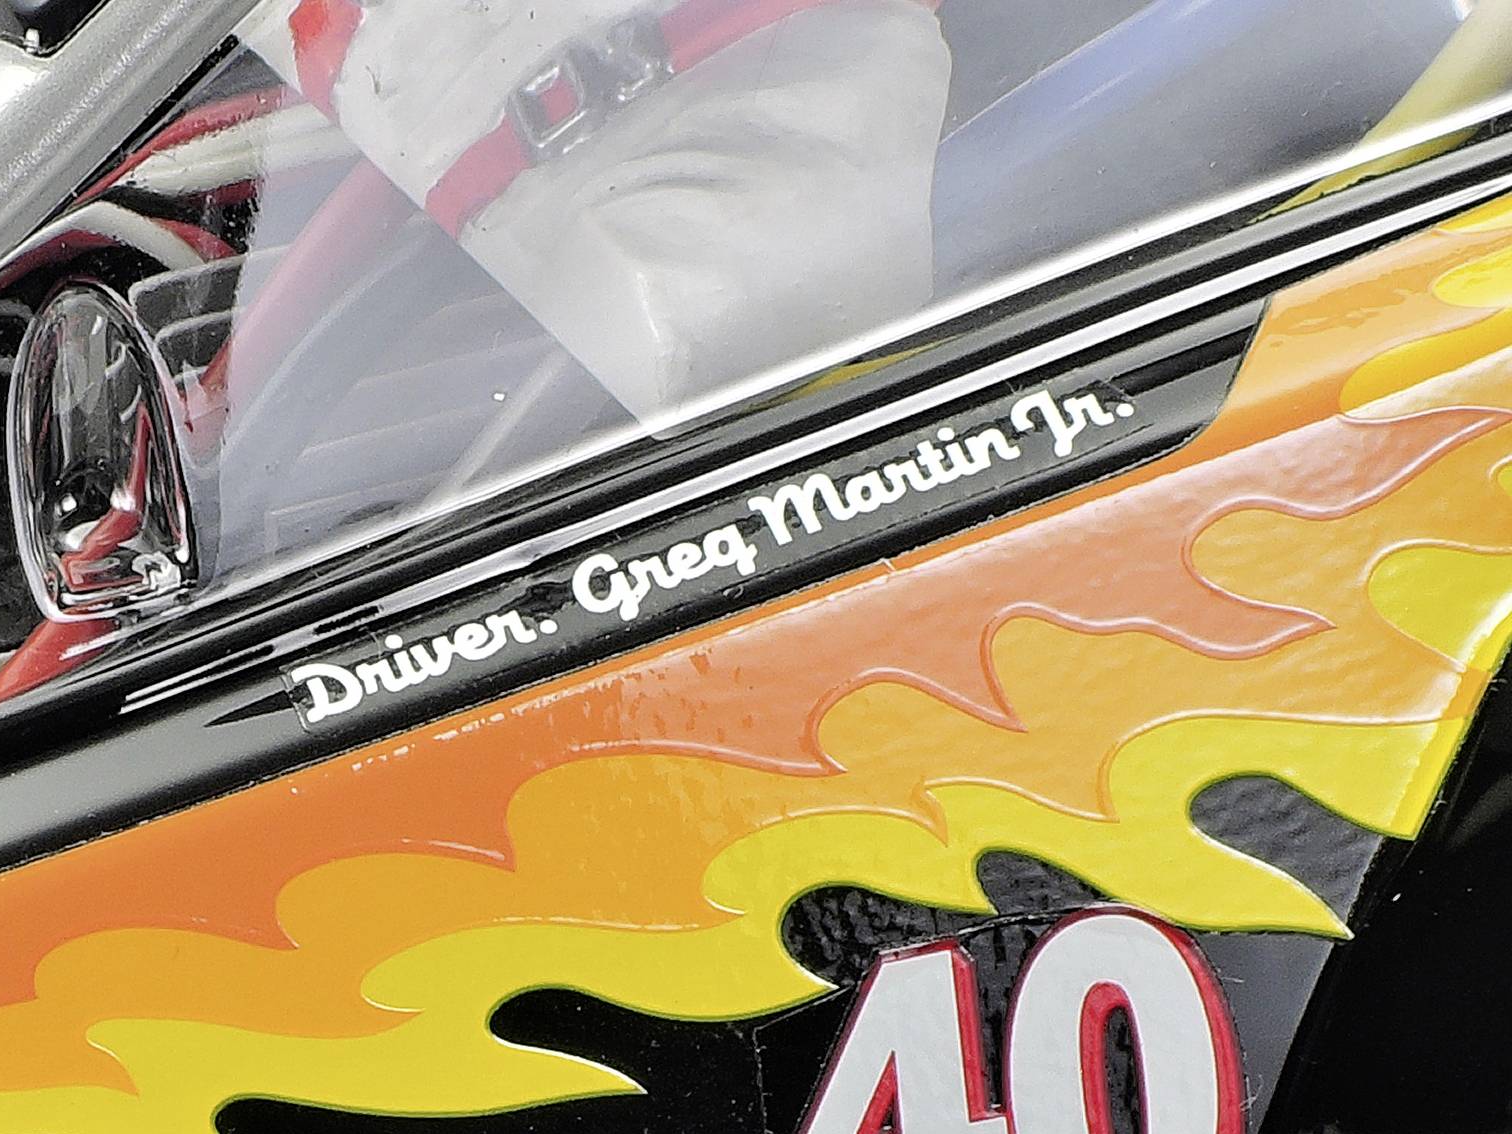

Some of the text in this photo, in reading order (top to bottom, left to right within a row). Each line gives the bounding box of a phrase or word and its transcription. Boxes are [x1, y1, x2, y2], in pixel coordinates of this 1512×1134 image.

[292, 387, 1135, 724] Driver. Greg Martin Jr.
